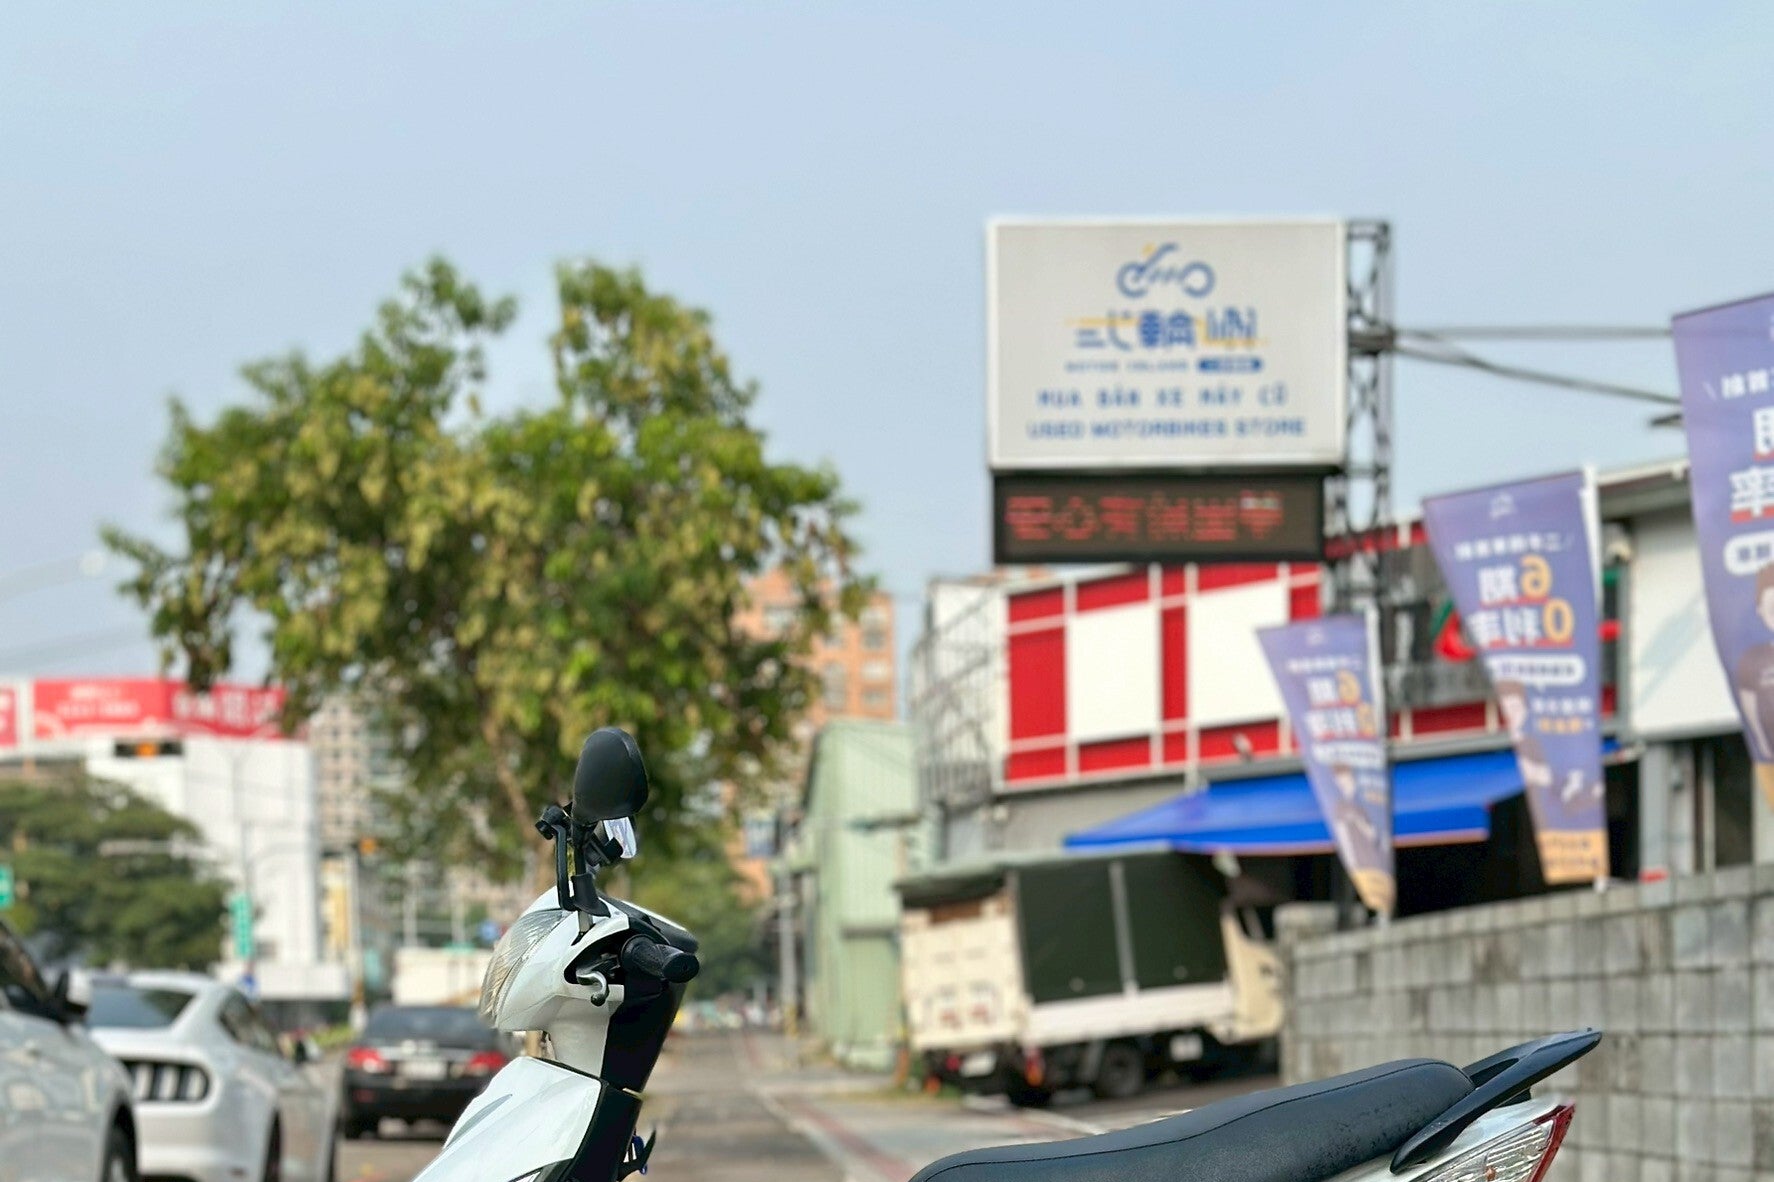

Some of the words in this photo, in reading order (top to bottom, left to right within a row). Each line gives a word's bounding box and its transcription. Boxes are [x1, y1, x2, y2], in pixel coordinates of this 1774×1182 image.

[1026, 420, 1084, 440] USED
[1091, 418, 1227, 438] MOTORBIKES
[1234, 417, 1306, 437] STORE
